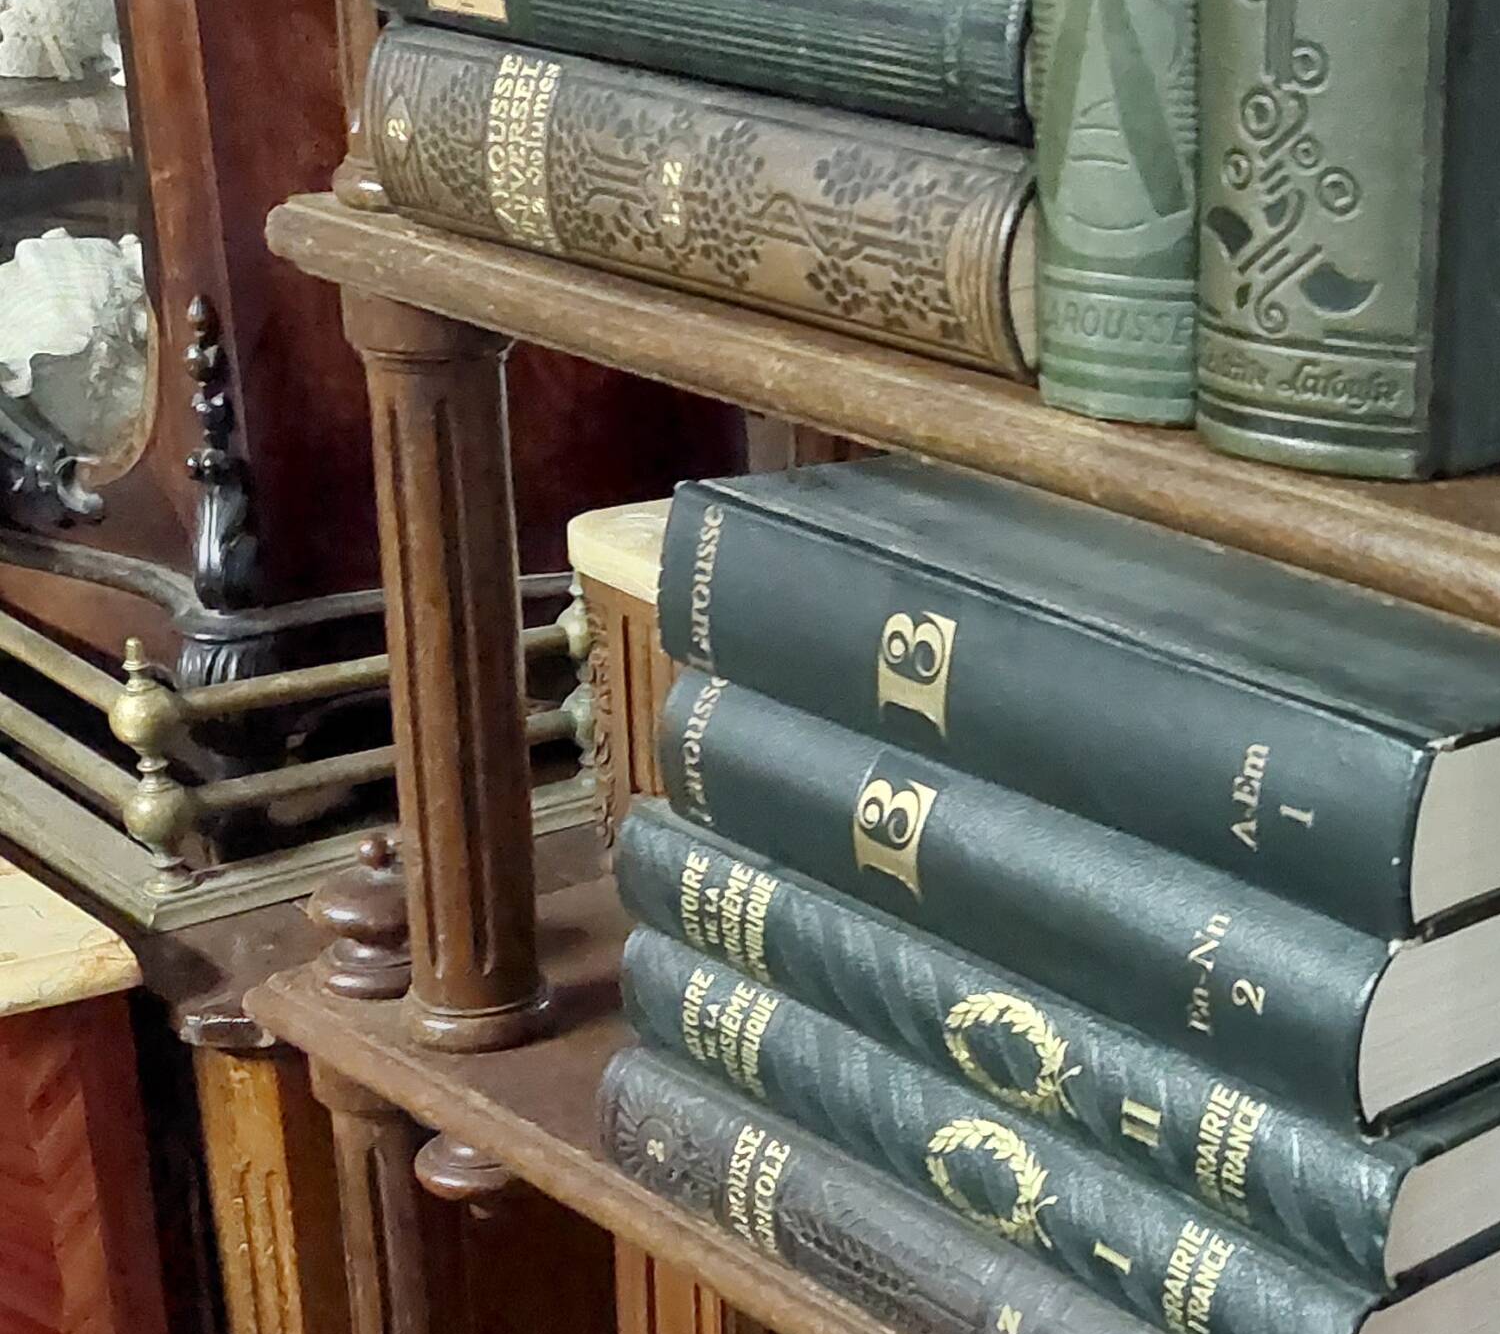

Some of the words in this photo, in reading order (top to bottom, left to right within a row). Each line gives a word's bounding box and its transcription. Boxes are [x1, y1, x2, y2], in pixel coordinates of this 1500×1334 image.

[704, 887, 721, 913] LA
[1231, 978, 1266, 1016] 2
[704, 1003, 722, 1030] LA
